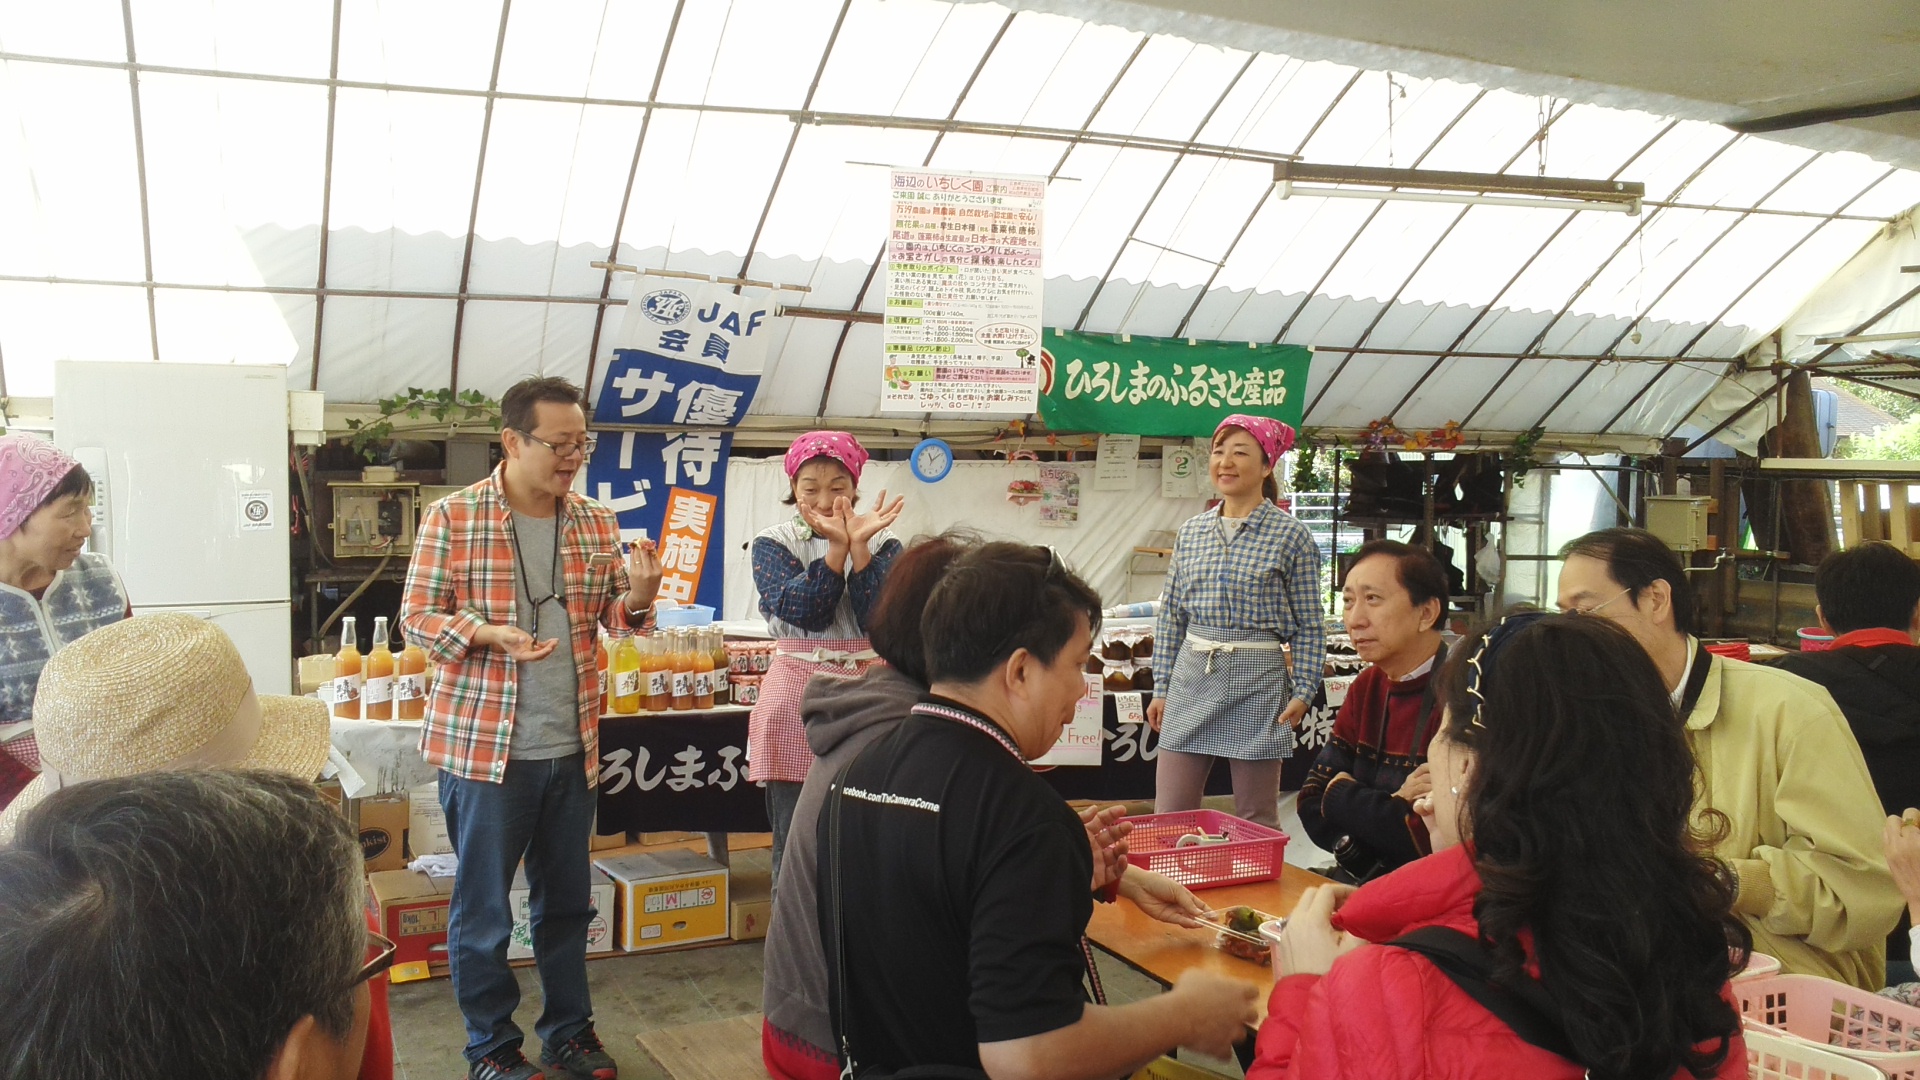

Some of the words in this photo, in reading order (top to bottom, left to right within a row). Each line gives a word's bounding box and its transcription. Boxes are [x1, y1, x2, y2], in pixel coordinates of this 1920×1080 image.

[894, 175, 983, 192] 海辺のいちじく園
[986, 185, 1007, 193] ご案内
[933, 193, 1002, 204] ありがとうございます
[697, 301, 767, 336] JAF
[658, 329, 731, 364] 会員
[1065, 359, 1287, 408] ひろしまのふるさと産品
[661, 380, 744, 486] 優待
[658, 495, 711, 601] 実施中
[1068, 728, 1102, 746] Free!
